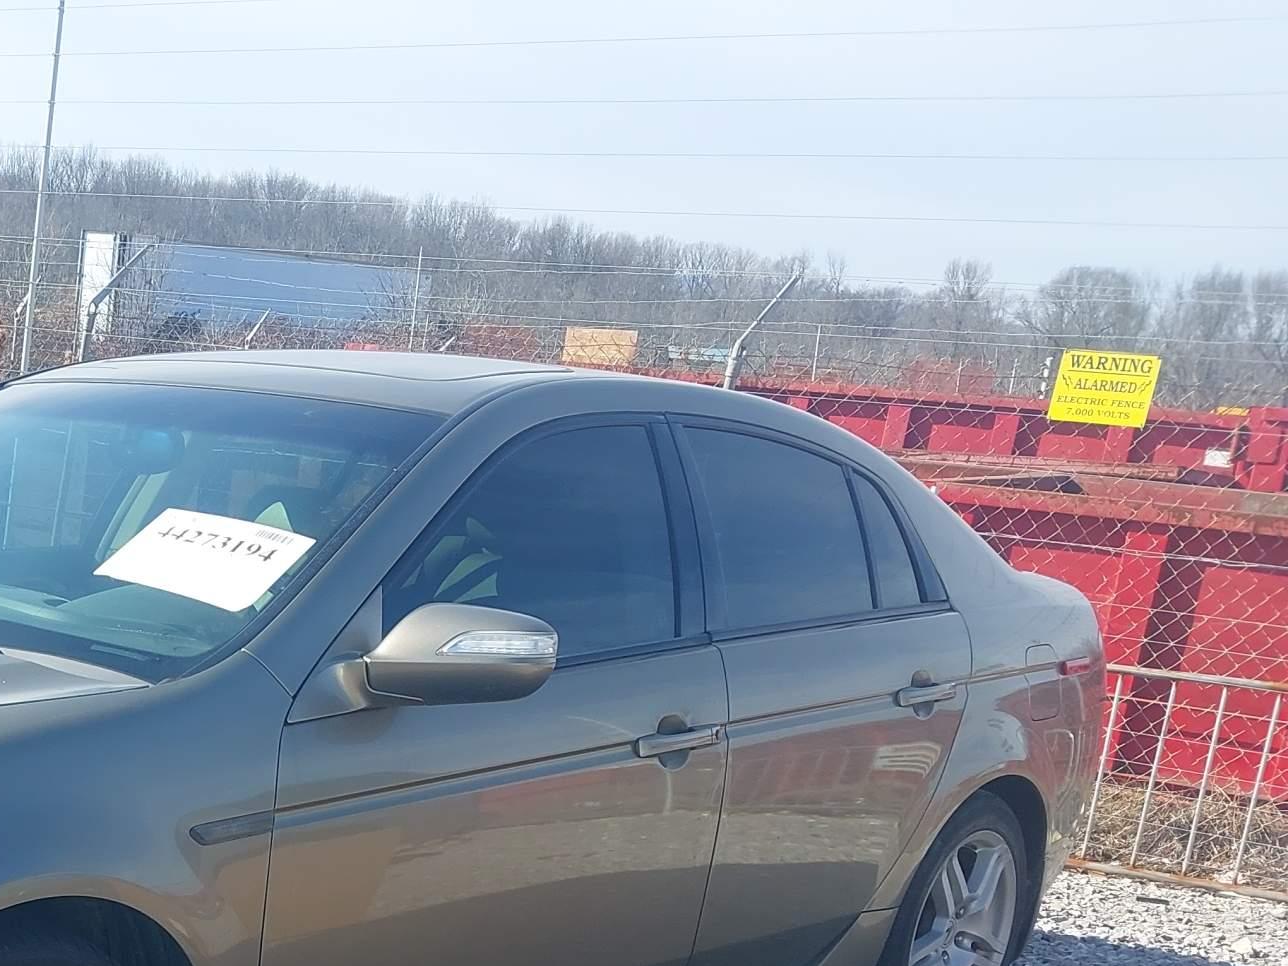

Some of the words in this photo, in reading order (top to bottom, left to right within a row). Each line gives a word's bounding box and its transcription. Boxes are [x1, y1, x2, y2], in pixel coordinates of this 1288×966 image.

[1071, 354, 1153, 374] WARNING
[1074, 378, 1138, 394] ALARMED
[1056, 395, 1110, 407] ELECTRIC
[1111, 399, 1145, 409] FENCE
[1097, 410, 1130, 420] VOLTS
[158, 526, 278, 561] 44273194
